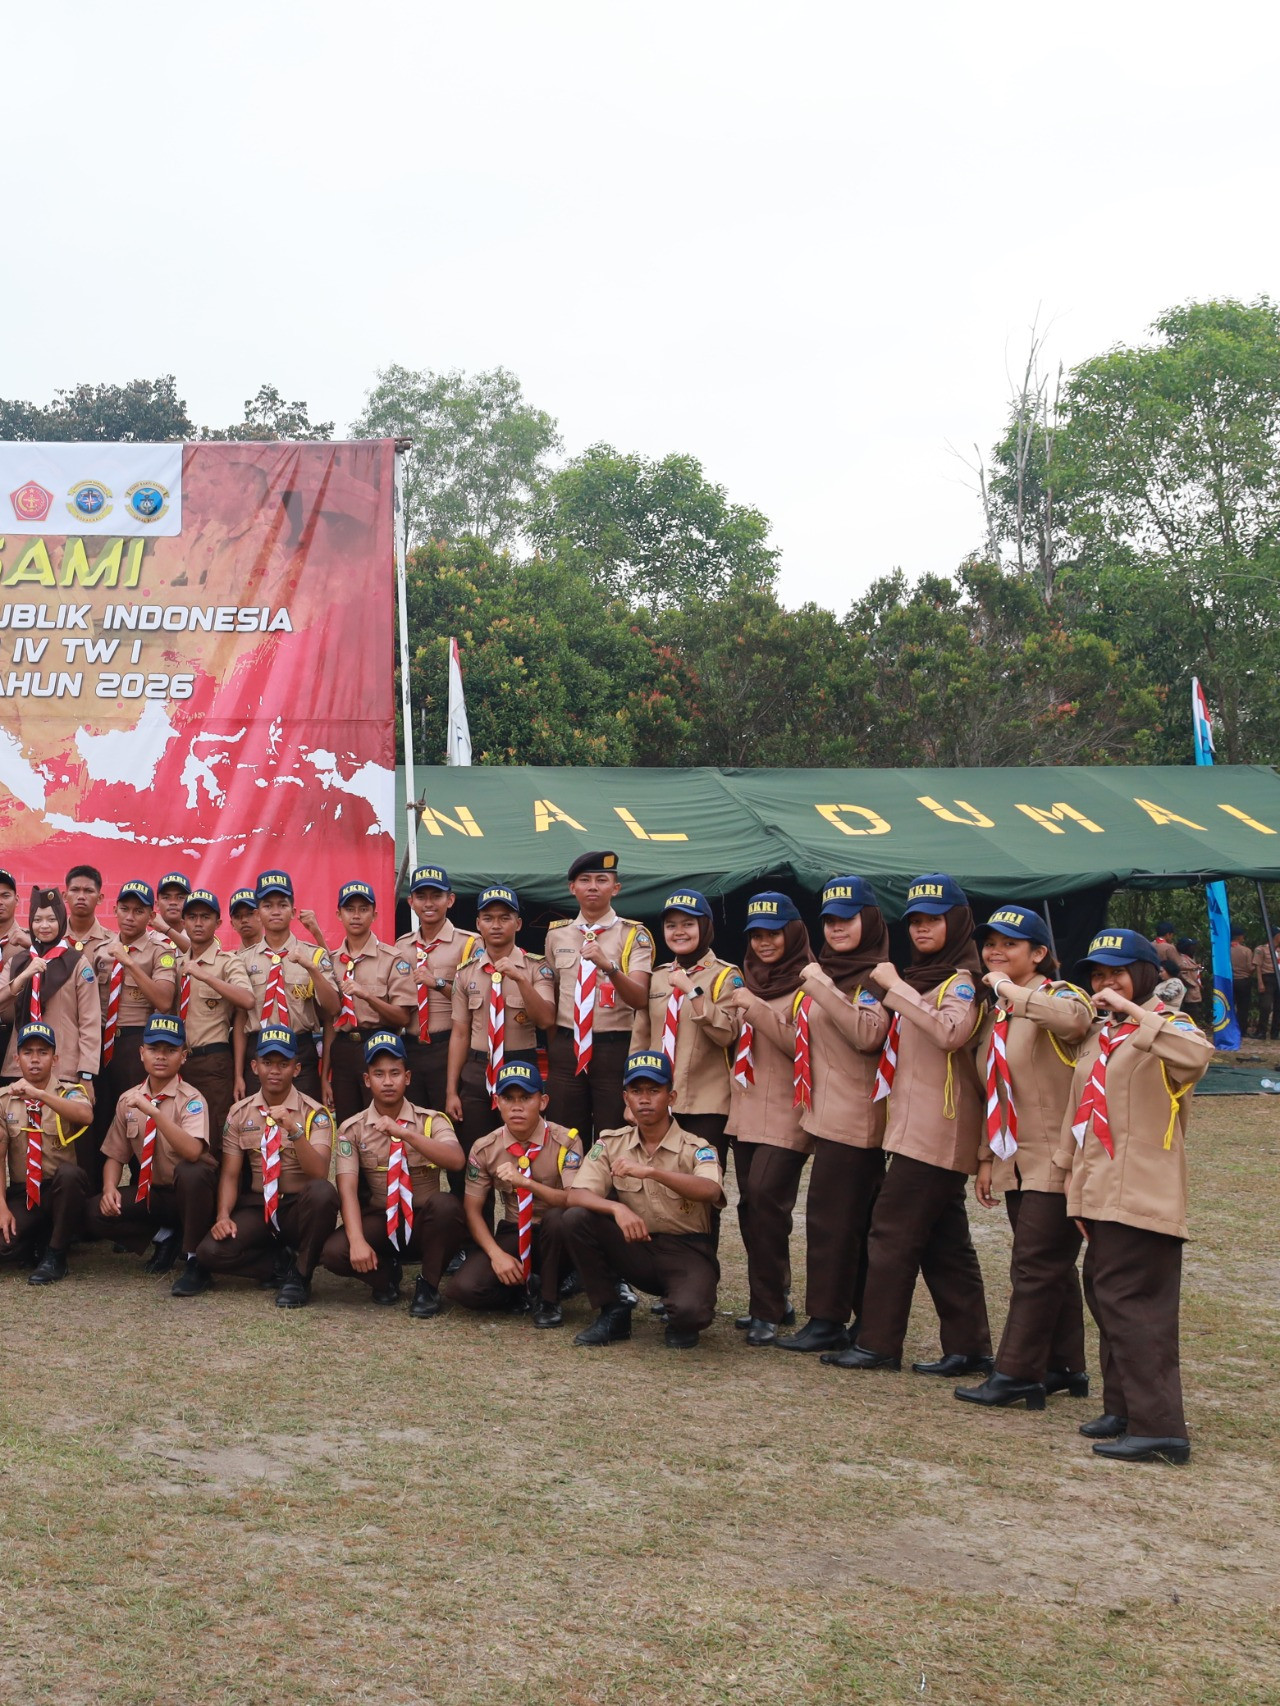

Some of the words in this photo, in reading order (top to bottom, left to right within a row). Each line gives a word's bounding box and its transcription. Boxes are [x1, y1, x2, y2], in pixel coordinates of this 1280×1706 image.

[102, 604, 293, 632] INDONESIA
[12, 637, 50, 663] IV
[61, 638, 121, 664] TW
[130, 638, 142, 665] I
[95, 672, 195, 699] 2026
[814, 795, 1278, 836] DUMAI
[261, 875, 287, 887] KKRI
[415, 869, 444, 882] KKRI
[122, 883, 149, 895] KKRI
[342, 884, 369, 895] KKRI
[482, 889, 512, 900] KKRI
[186, 892, 213, 903] KKRI
[230, 892, 255, 904] KKRI
[664, 895, 697, 907] KKRI
[23, 1025, 51, 1036] KKRI
[150, 1018, 179, 1033] KKRI
[261, 1030, 291, 1043] KKRI
[367, 1034, 397, 1049] KKRI
[629, 1056, 662, 1072] KKRI
[499, 1066, 531, 1081] KKRI
